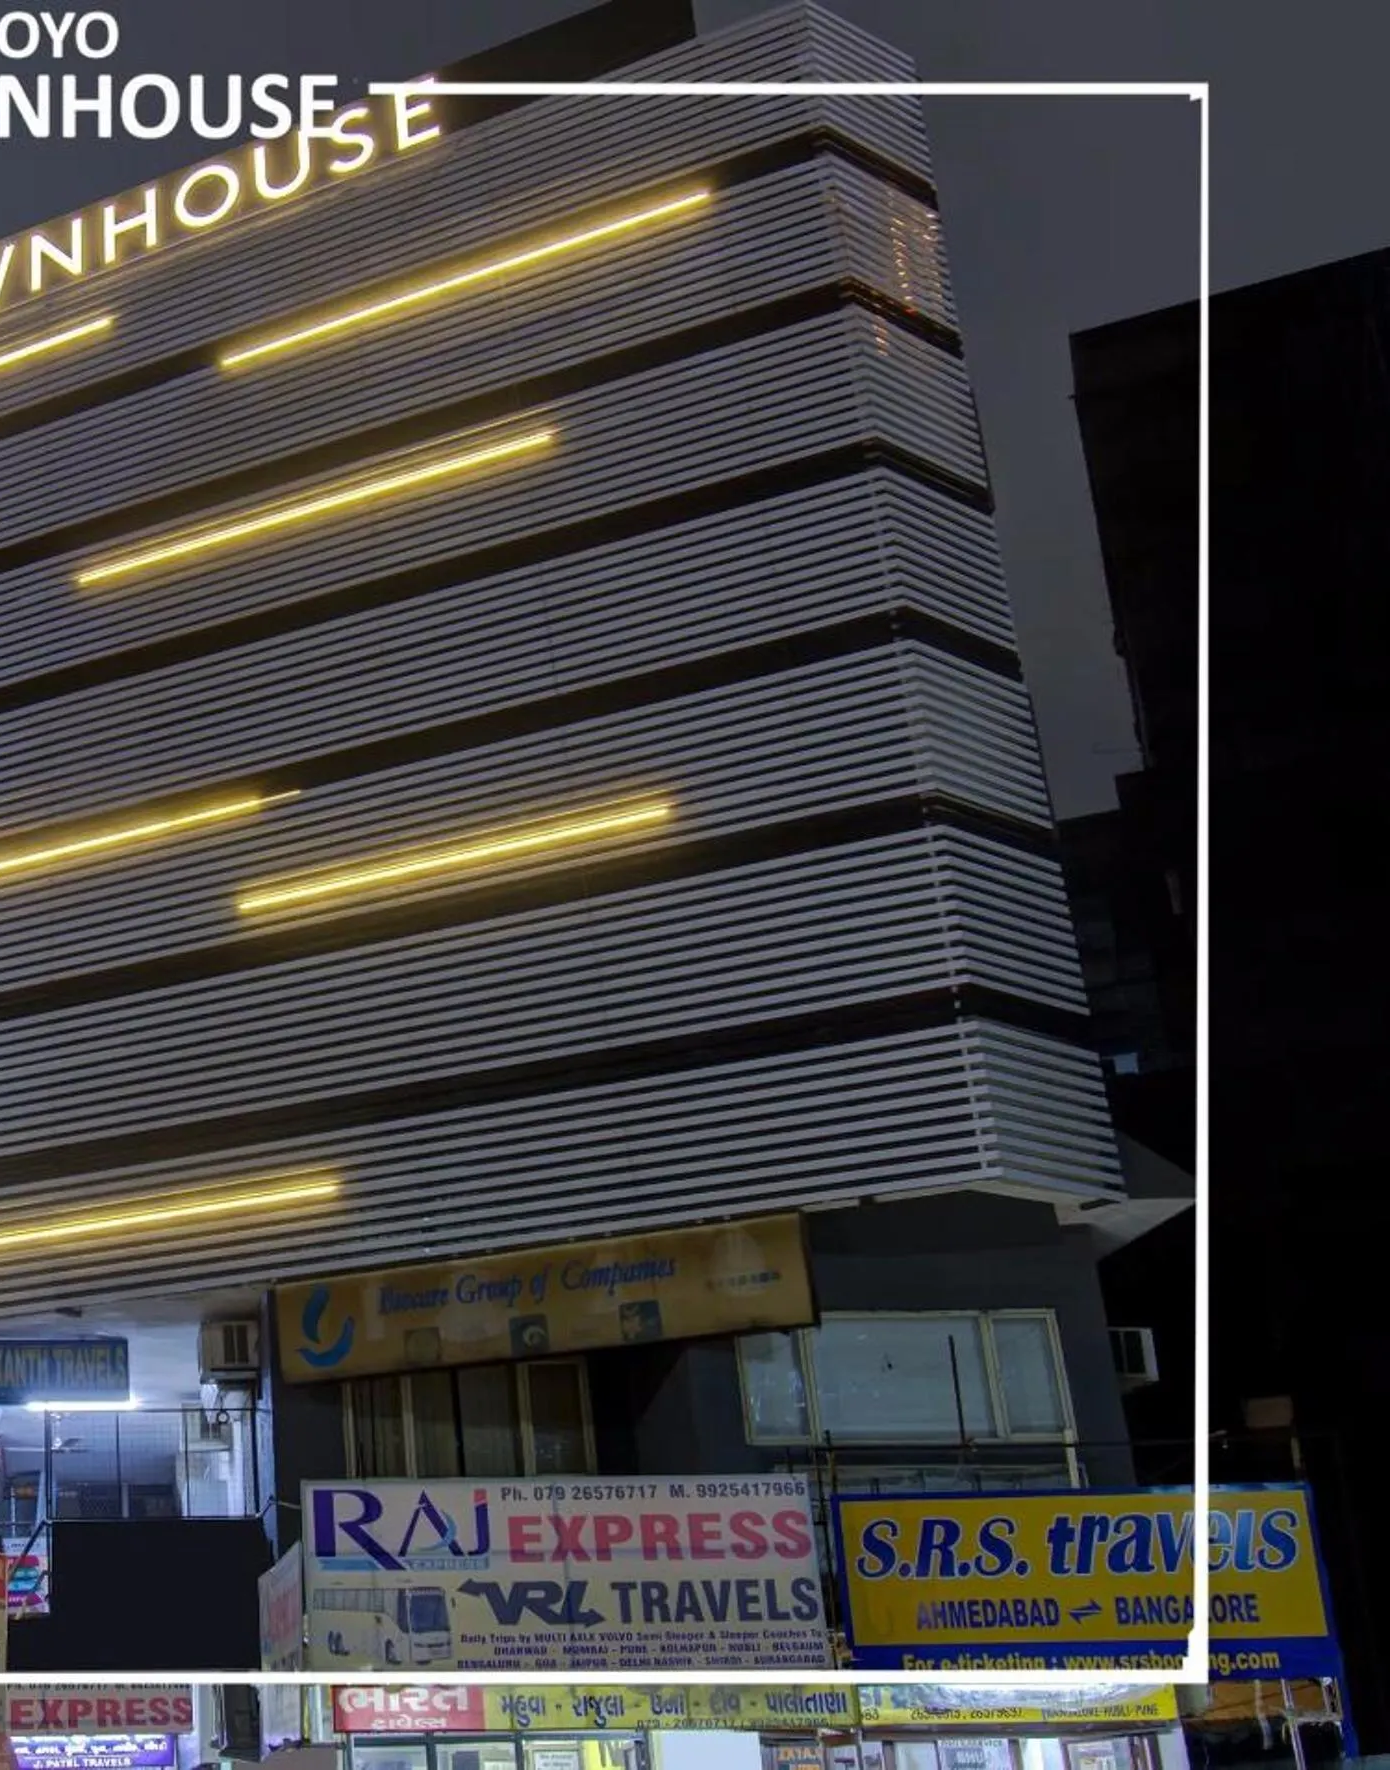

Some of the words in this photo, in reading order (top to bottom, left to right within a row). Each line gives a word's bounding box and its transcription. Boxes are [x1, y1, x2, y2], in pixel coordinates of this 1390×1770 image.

[455, 1273, 524, 1308] Group
[529, 1266, 553, 1302] of
[560, 1256, 677, 1298] Companies
[55, 1346, 126, 1390] TRAVELS
[500, 1487, 527, 1502] Ph.
[533, 1485, 566, 1501] 079
[669, 1484, 691, 1499] M.
[312, 1487, 491, 1571] RAJ
[507, 1510, 813, 1564] EXPRESS
[856, 1515, 1031, 1580] S.R.S.
[457, 1578, 606, 1627] VRL
[610, 1576, 820, 1625] TRAVELS
[916, 1597, 1060, 1631] AHMEDABAD
[1115, 1593, 1261, 1625] BANGAORE
[599, 1632, 633, 1642] VOLVO
[902, 1654, 935, 1671] For
[10, 1696, 192, 1730] EXPRESS
